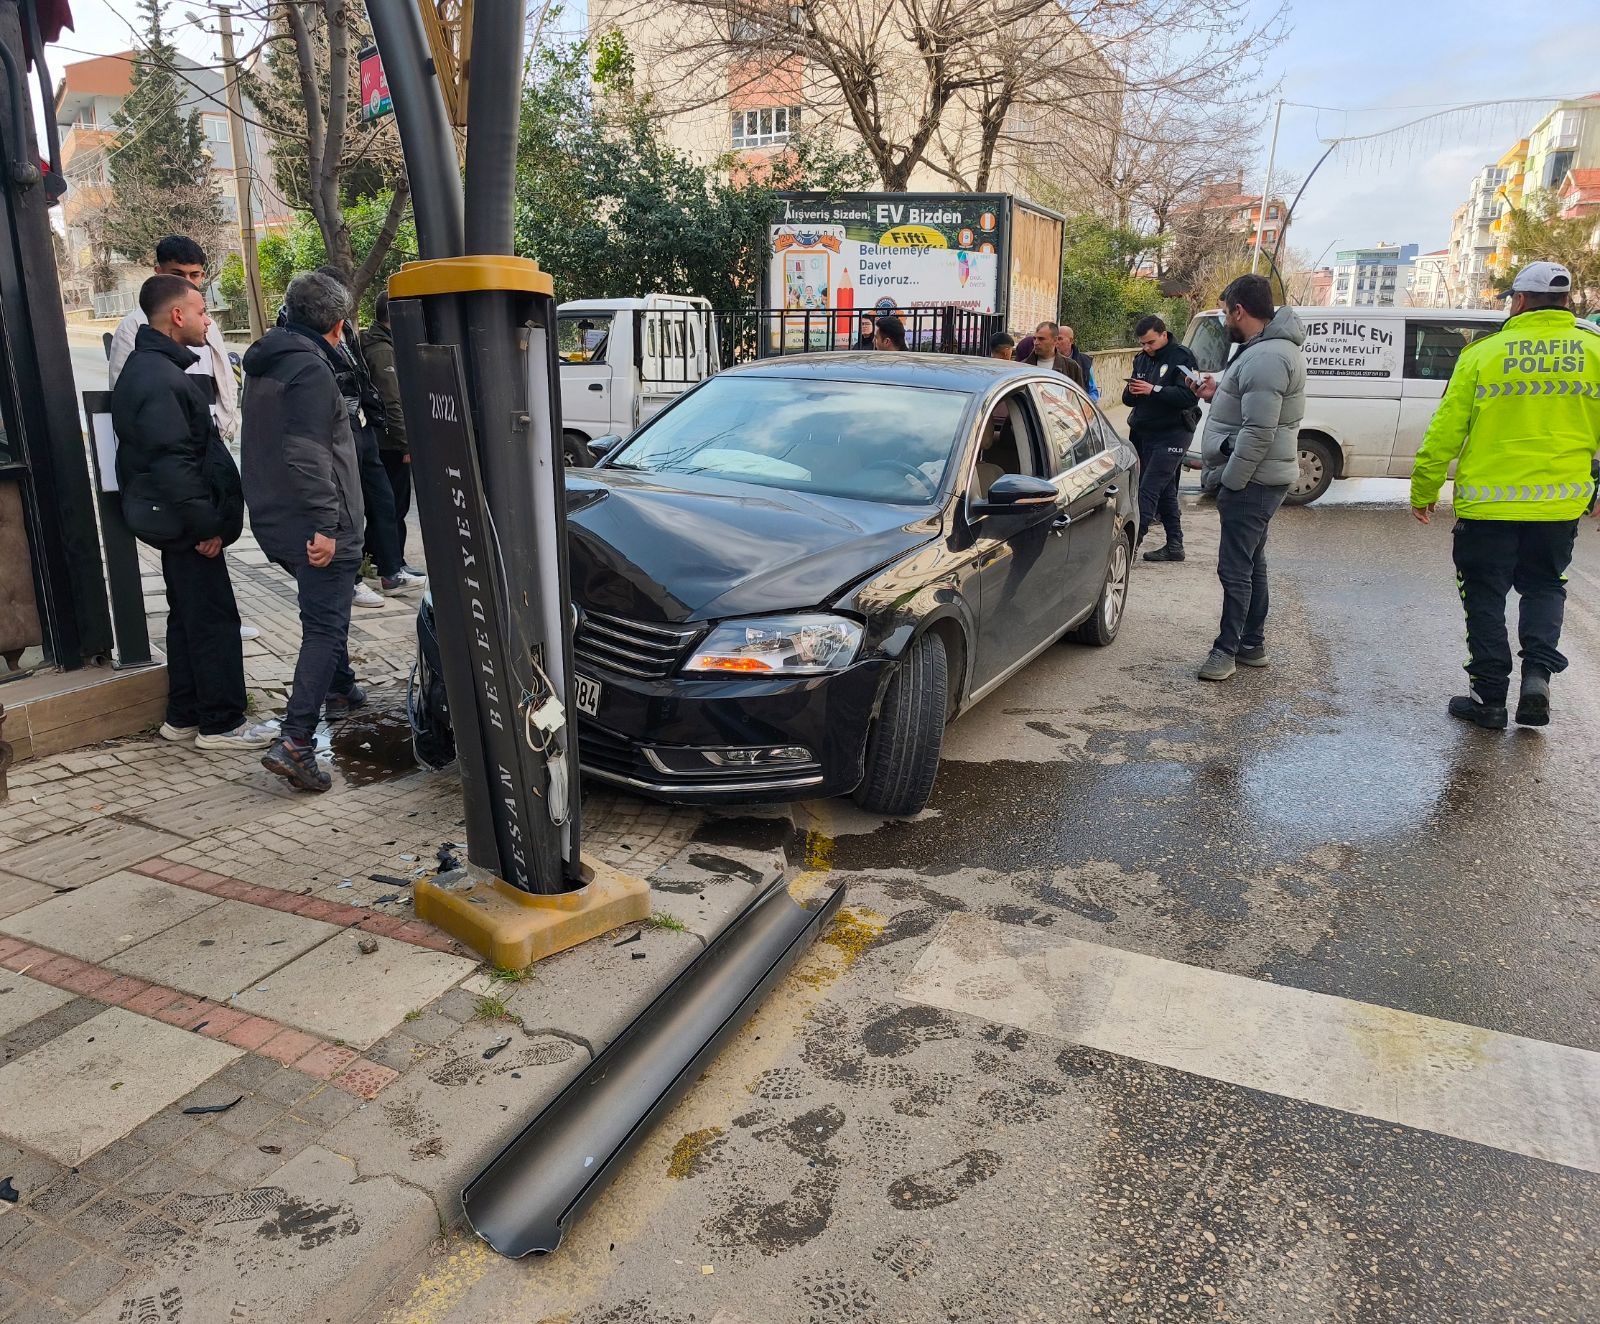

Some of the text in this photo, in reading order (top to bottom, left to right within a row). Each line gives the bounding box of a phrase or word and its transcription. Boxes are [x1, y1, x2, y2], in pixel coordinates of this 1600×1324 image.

[876, 204, 905, 224] EV
[909, 208, 962, 224] Bizden
[890, 232, 928, 244] Fifti
[860, 260, 892, 271] Davet
[860, 273, 920, 287] Ediyoruz...
[1333, 319, 1366, 341] PİLİÇ
[1370, 327, 1393, 346] EVİ
[1342, 344, 1382, 354] MEVLİT
[1306, 356, 1365, 366] YEMEKLERİ
[429, 392, 458, 422] 2022
[445, 466, 504, 731] BELEDİYESİ
